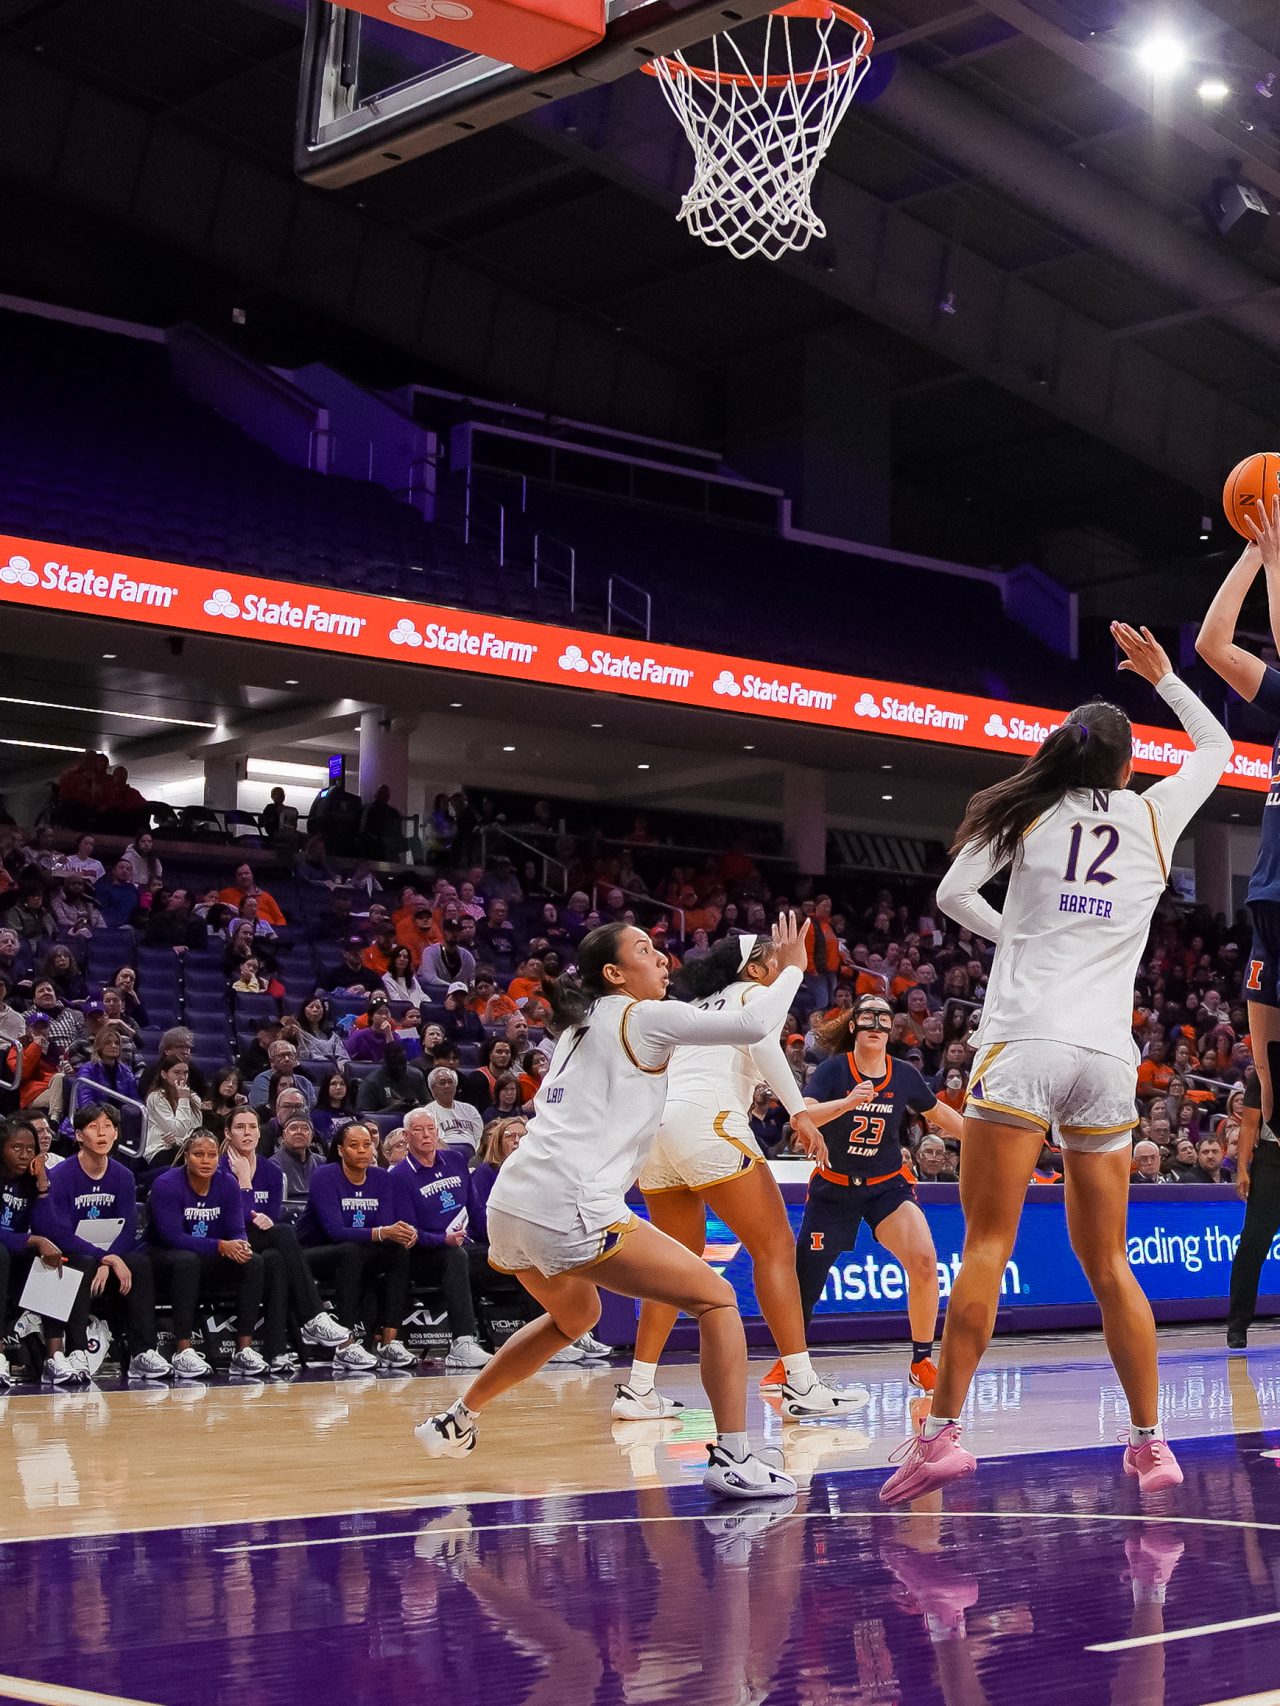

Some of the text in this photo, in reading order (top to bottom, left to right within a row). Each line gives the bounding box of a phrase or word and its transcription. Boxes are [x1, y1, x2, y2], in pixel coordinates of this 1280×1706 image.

[1092, 789, 1111, 813] N
[1062, 820, 1120, 888] 12
[1058, 893, 1113, 919] HARTER
[546, 1087, 565, 1104] LAU
[849, 1115, 886, 1145] 23
